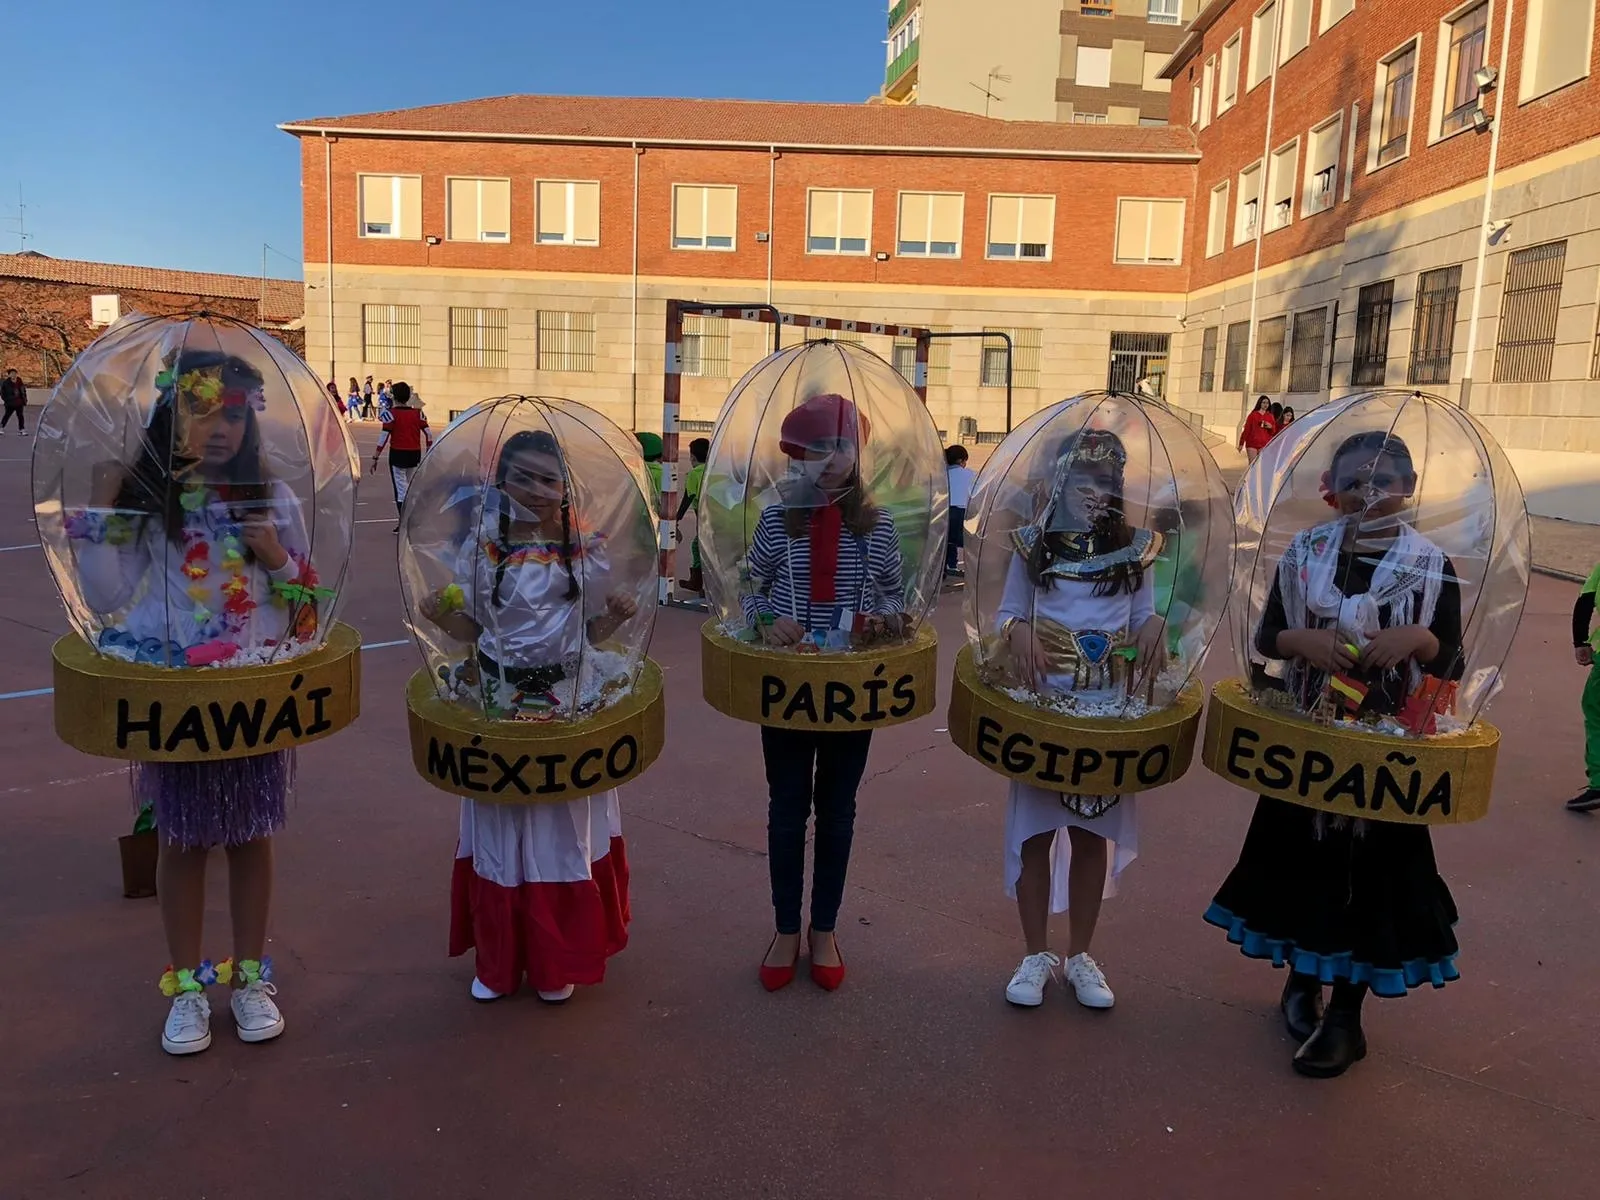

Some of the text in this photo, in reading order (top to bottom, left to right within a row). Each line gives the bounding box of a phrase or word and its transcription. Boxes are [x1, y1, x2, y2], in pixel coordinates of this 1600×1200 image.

[116, 673, 332, 752] HAWÁI
[761, 663, 916, 724] PARÍS
[427, 733, 638, 795] MÉXICO
[975, 715, 1170, 788] EGIPTO
[1226, 726, 1452, 816] ESPAÑA
